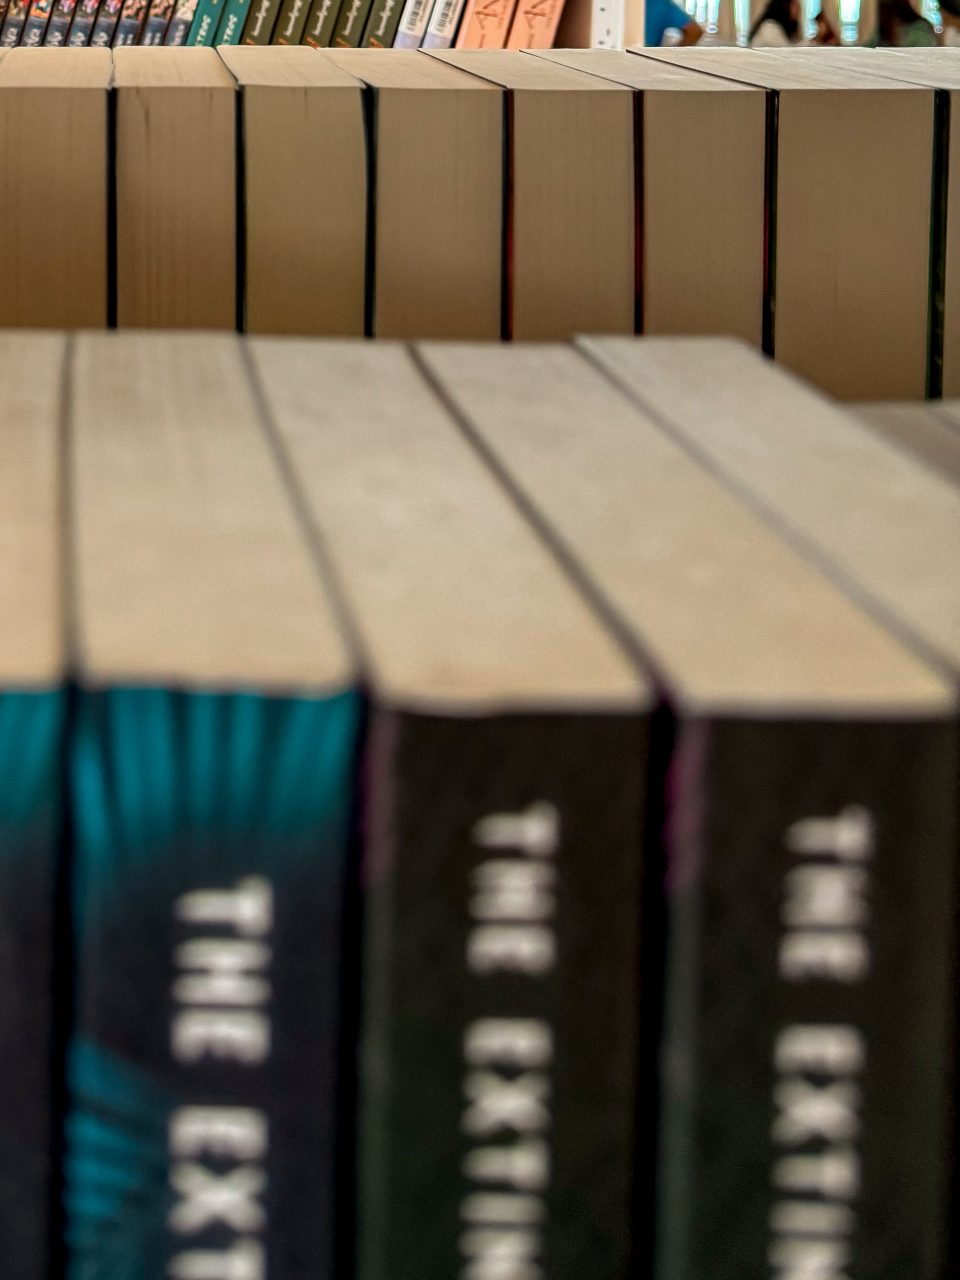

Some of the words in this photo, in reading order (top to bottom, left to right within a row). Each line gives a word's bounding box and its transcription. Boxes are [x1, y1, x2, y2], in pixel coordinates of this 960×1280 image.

[172, 875, 274, 1063] THE
[468, 803, 558, 974] THE
[780, 806, 872, 980] THE
